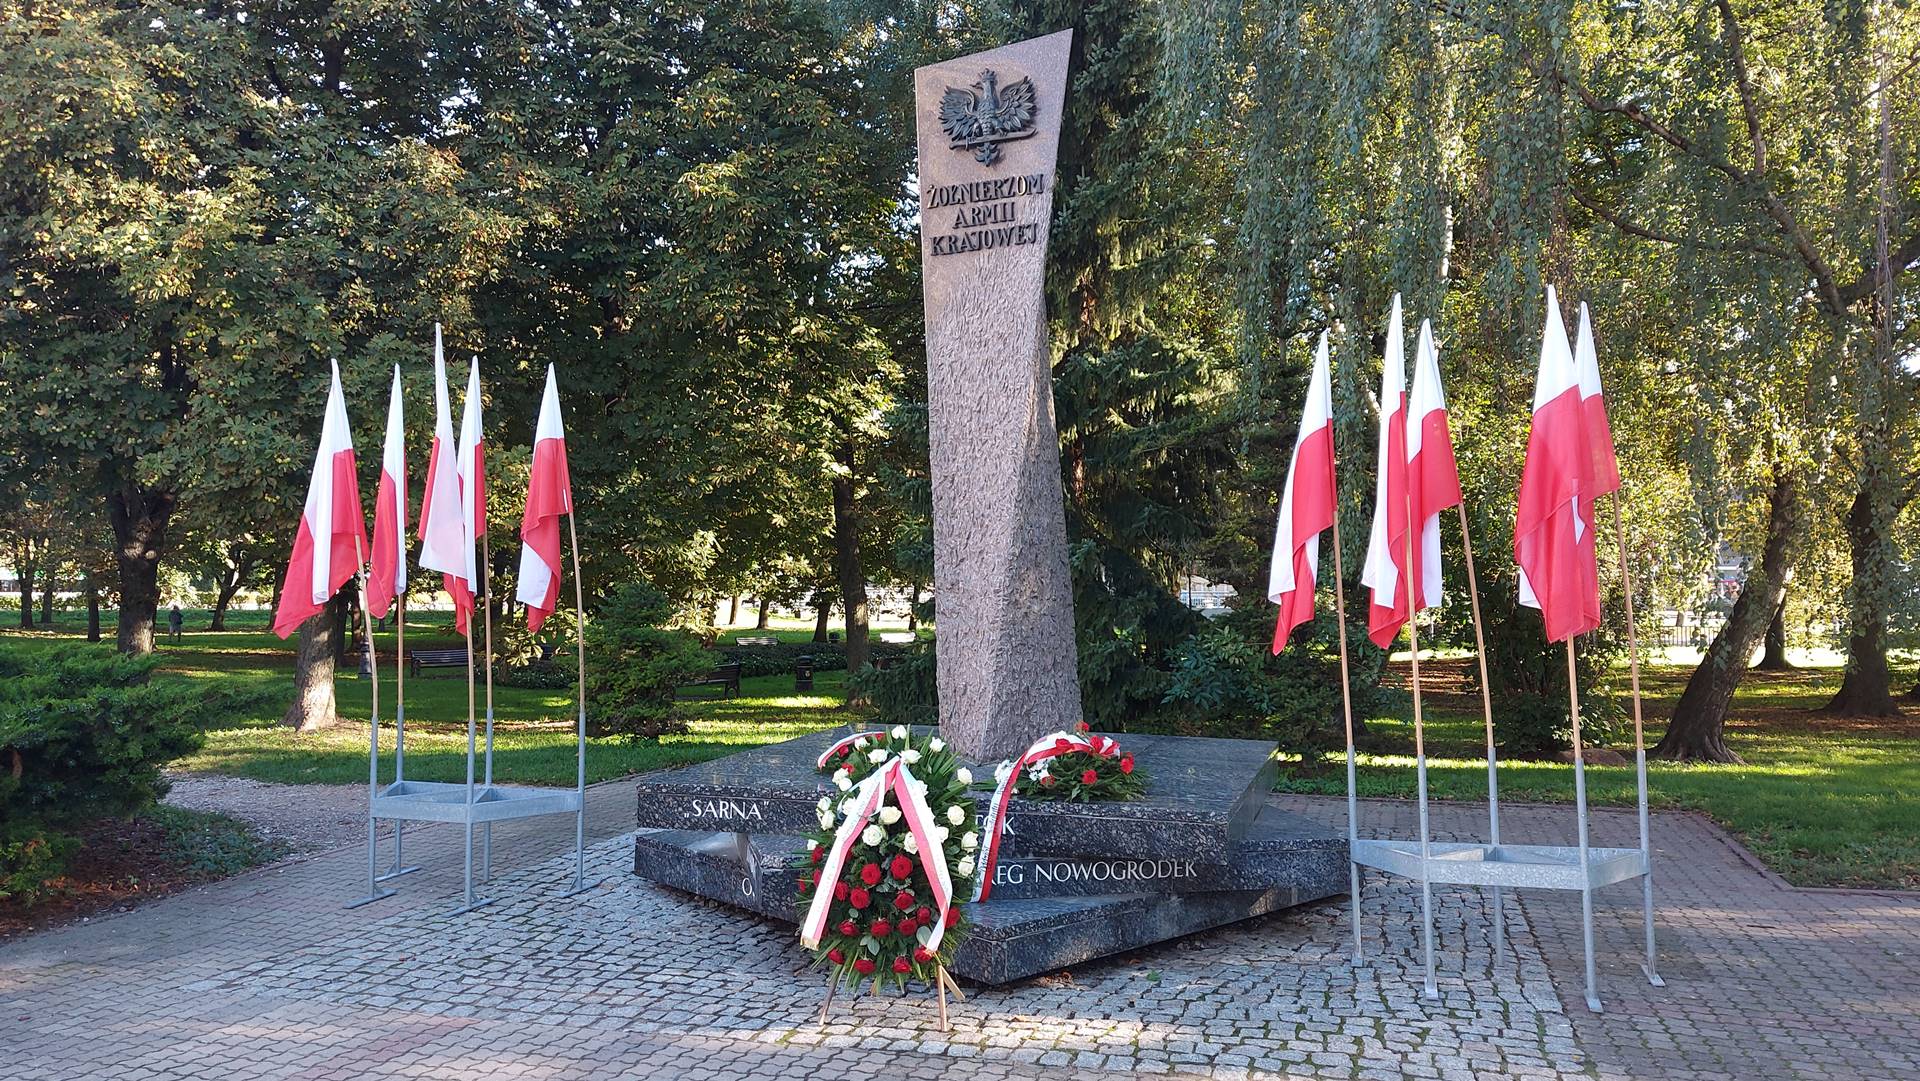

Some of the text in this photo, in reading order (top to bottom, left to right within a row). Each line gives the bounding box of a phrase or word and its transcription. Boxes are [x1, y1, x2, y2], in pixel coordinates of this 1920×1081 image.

[926, 174, 1044, 209] ŻOŁNIERZOM
[952, 202, 1016, 229] ARMII
[930, 223, 1038, 256] KRAJOWEJ
